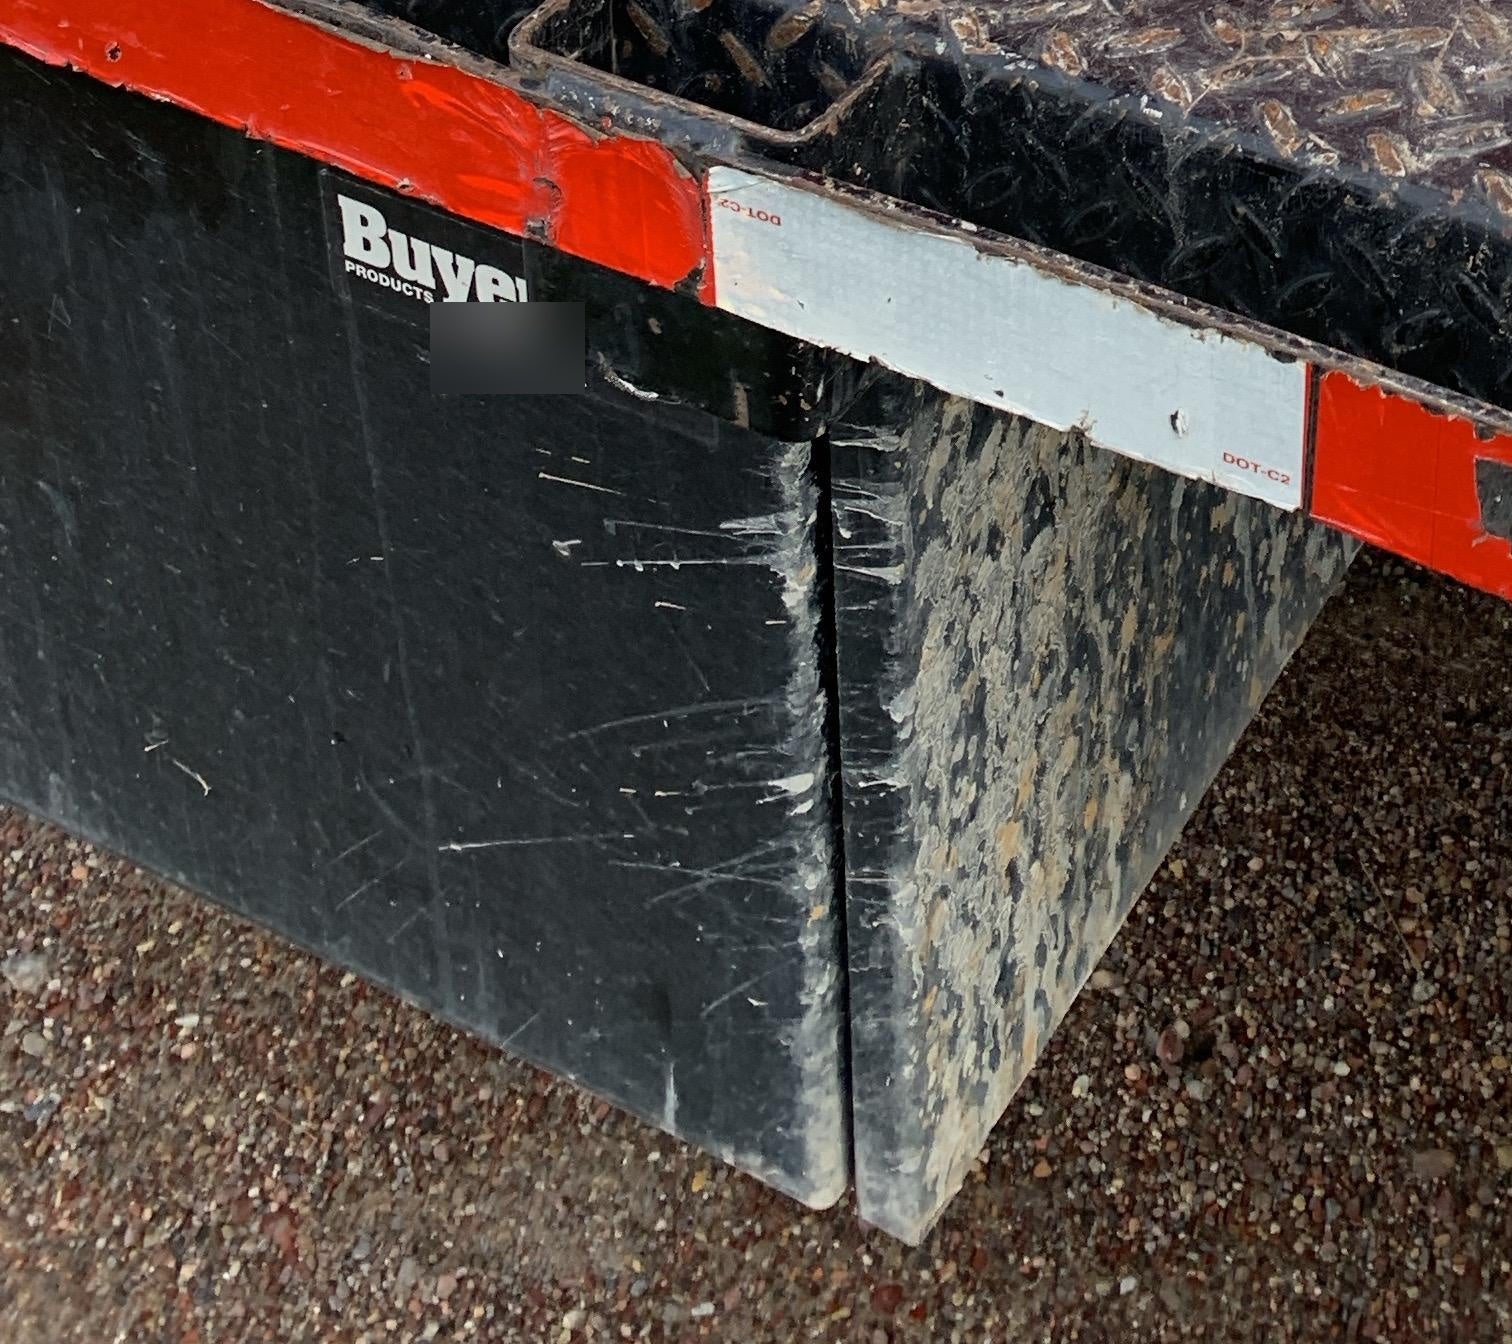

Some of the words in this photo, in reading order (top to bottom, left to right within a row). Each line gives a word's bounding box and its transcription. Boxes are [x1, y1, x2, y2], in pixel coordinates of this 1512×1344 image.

[719, 198, 782, 226] DOT-C2
[344, 259, 435, 304] PRODUCTS
[1223, 451, 1290, 485] DOT-C2
